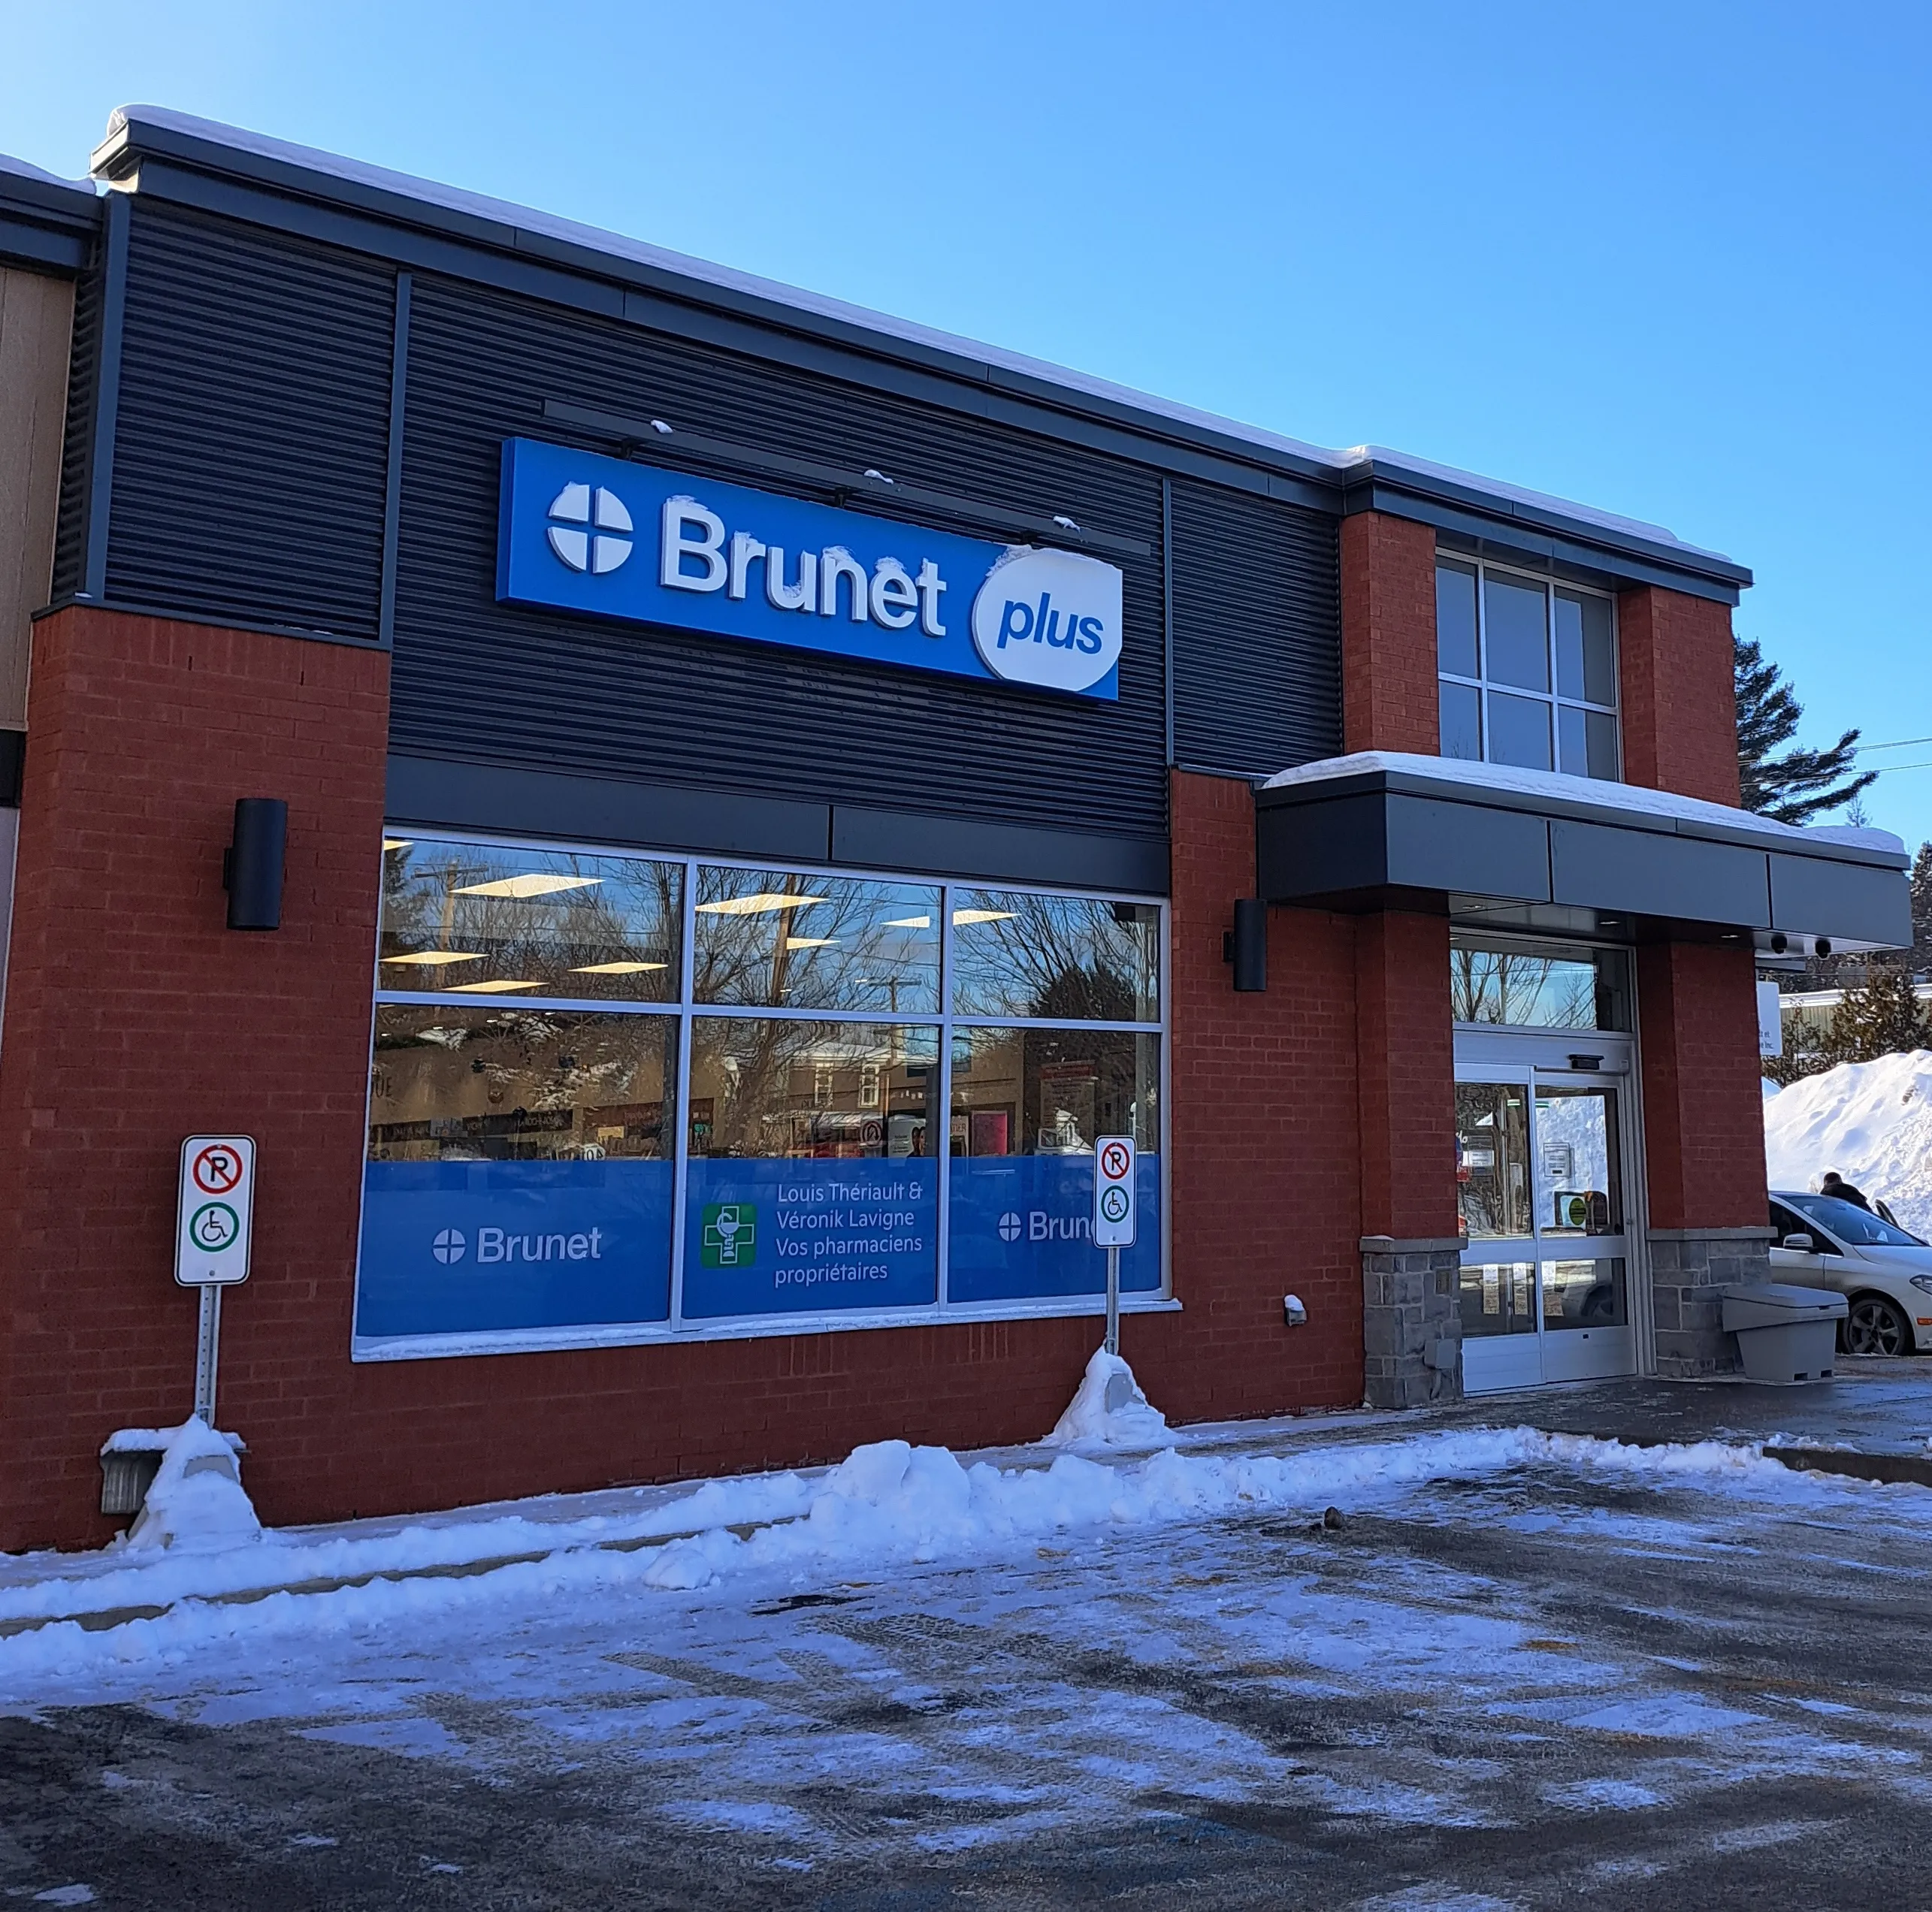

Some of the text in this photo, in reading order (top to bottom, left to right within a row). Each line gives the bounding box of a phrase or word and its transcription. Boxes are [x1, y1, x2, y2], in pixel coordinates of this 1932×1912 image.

[661, 497, 1104, 654] Brunet plus
[210, 1157, 228, 1182] P
[1111, 1151, 1122, 1171] P
[778, 1181, 924, 1203] Louis Thériault &
[776, 1208, 915, 1231] Véronik Lavigne
[477, 1226, 603, 1263] Brunet
[776, 1235, 923, 1259] Vos pharmaciens
[775, 1261, 888, 1288] propriétaires
